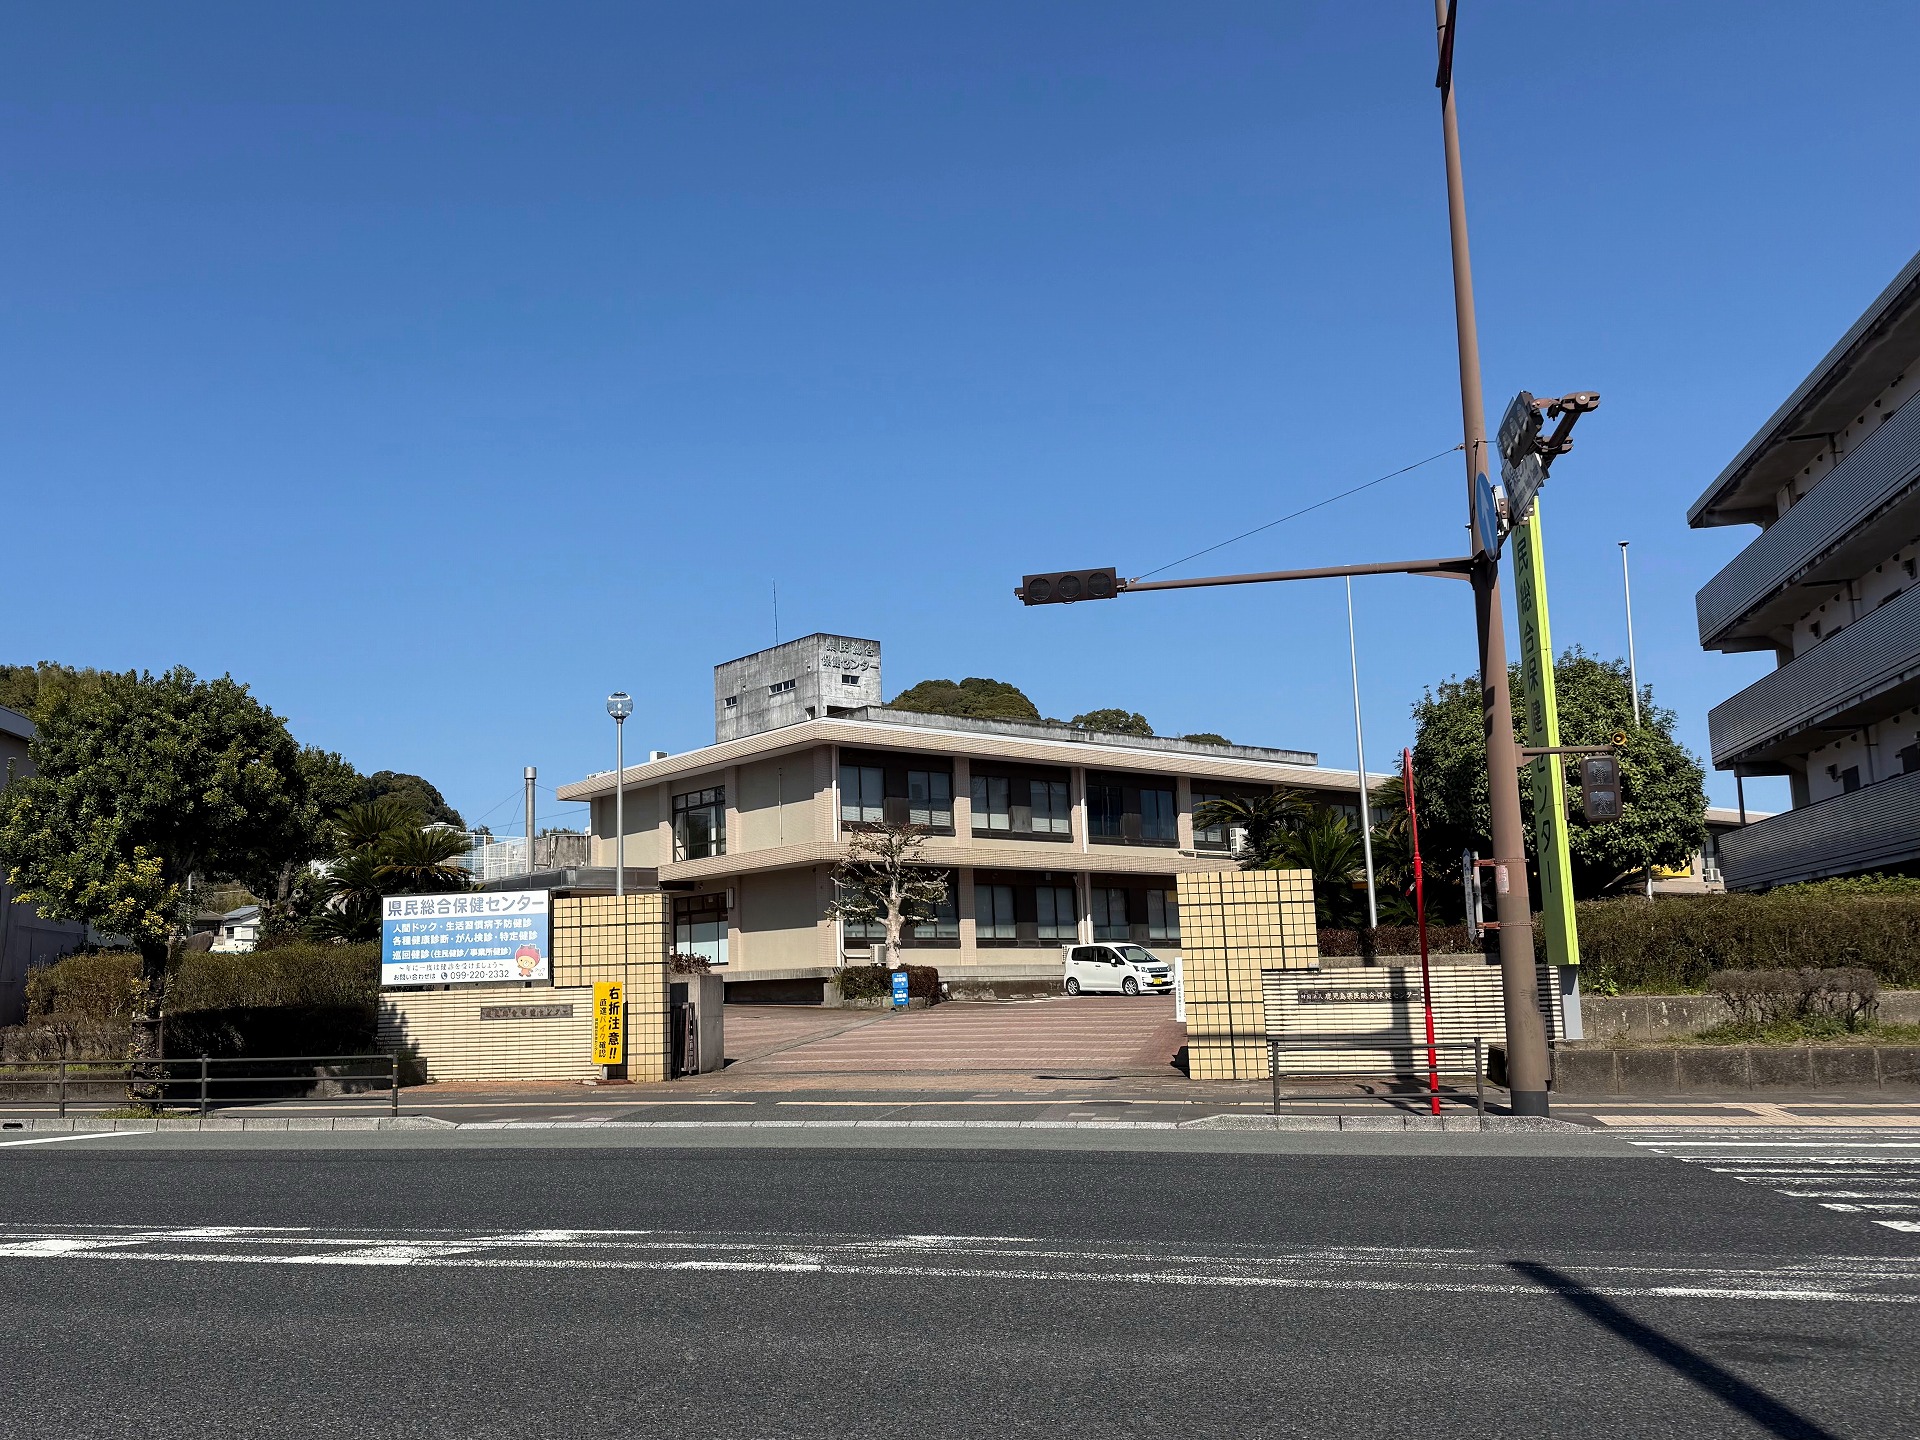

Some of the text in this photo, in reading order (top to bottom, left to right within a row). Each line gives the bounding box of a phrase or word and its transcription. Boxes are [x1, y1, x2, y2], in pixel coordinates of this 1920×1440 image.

[388, 895, 544, 917] 県民総合保健センター
[393, 917, 533, 933] 人間ドック・生活習慣病予防健診
[392, 930, 538, 946] 各種健康診断・がん検診・特定健診
[450, 970, 509, 980] 099-220-2332
[598, 998, 607, 1058] 直進バイク確認
